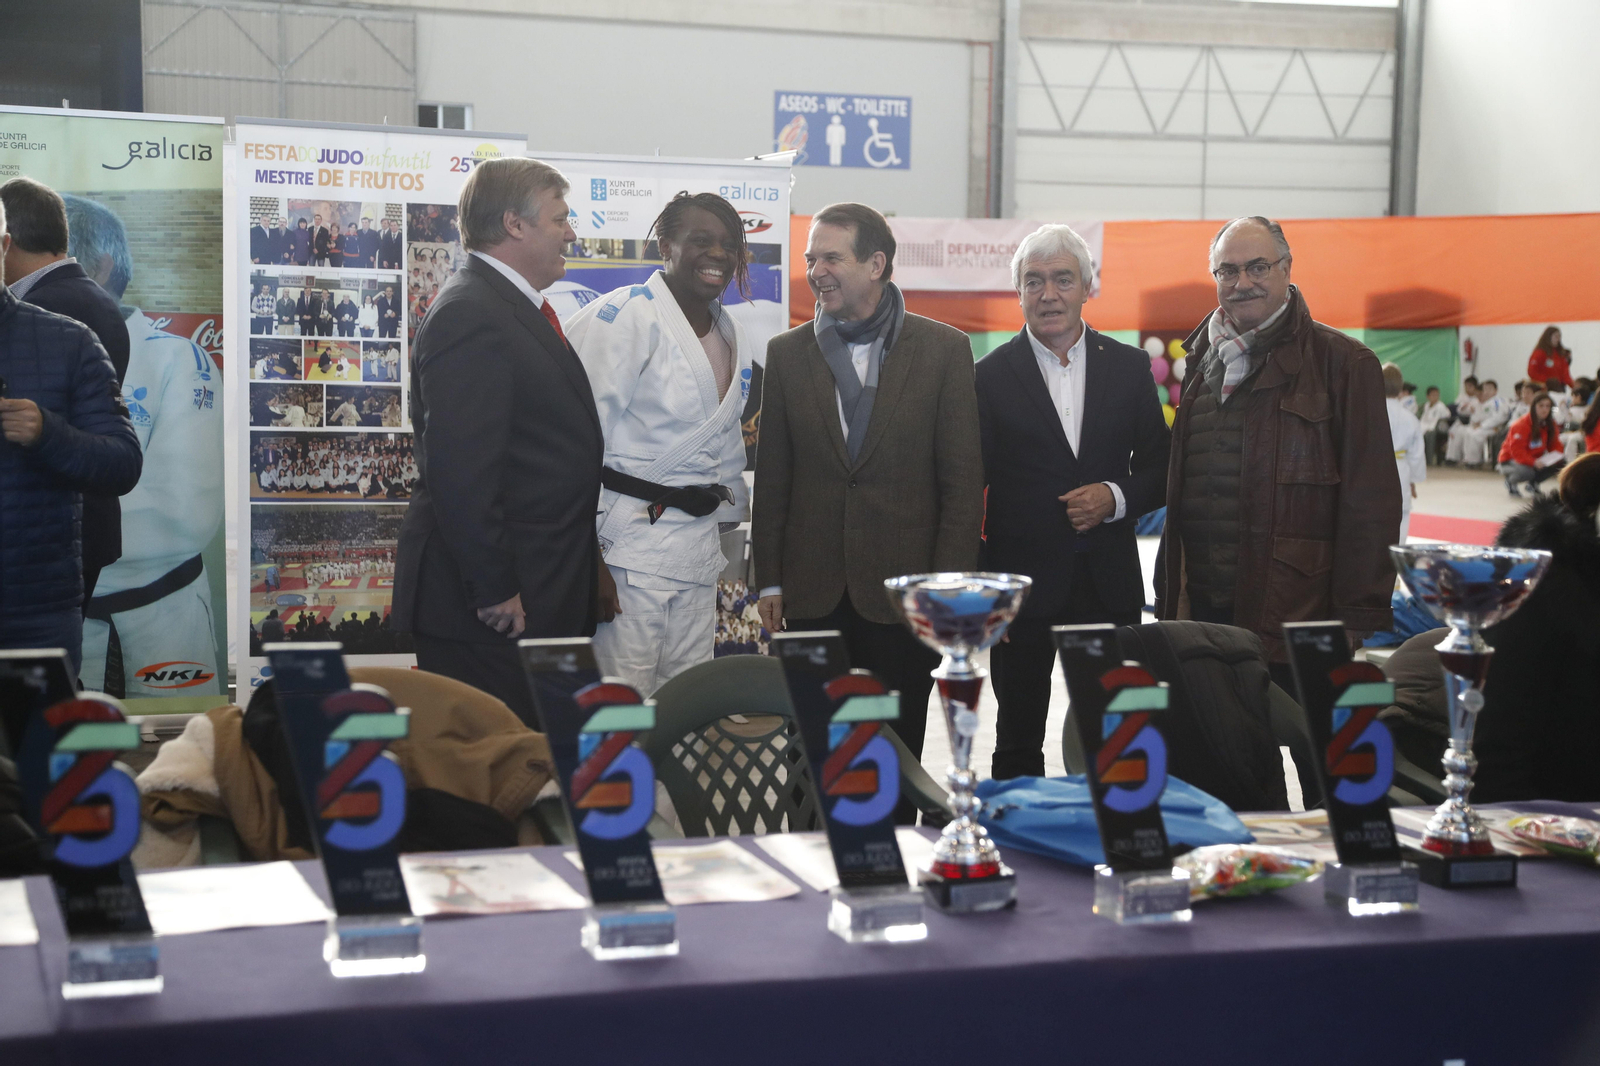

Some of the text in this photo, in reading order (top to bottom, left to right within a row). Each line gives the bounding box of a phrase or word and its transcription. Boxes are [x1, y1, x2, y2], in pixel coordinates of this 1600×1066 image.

[778, 94, 819, 114] ASEOS
[825, 96, 847, 115] WC
[852, 97, 909, 118] TOILETTE
[10, 142, 47, 151] GALICIA
[102, 136, 213, 170] galicia
[244, 142, 432, 180] FESTA DO JUDO infantil
[450, 156, 470, 173] 25
[255, 168, 425, 192] MESTRE DE FRUTOS
[609, 180, 635, 188] XUNTA
[609, 188, 652, 197] DE GALICIA
[719, 182, 779, 201] galicia
[743, 219, 769, 229] KL
[948, 241, 1019, 255] DEPUTACIÓ
[143, 669, 210, 682] NKL
